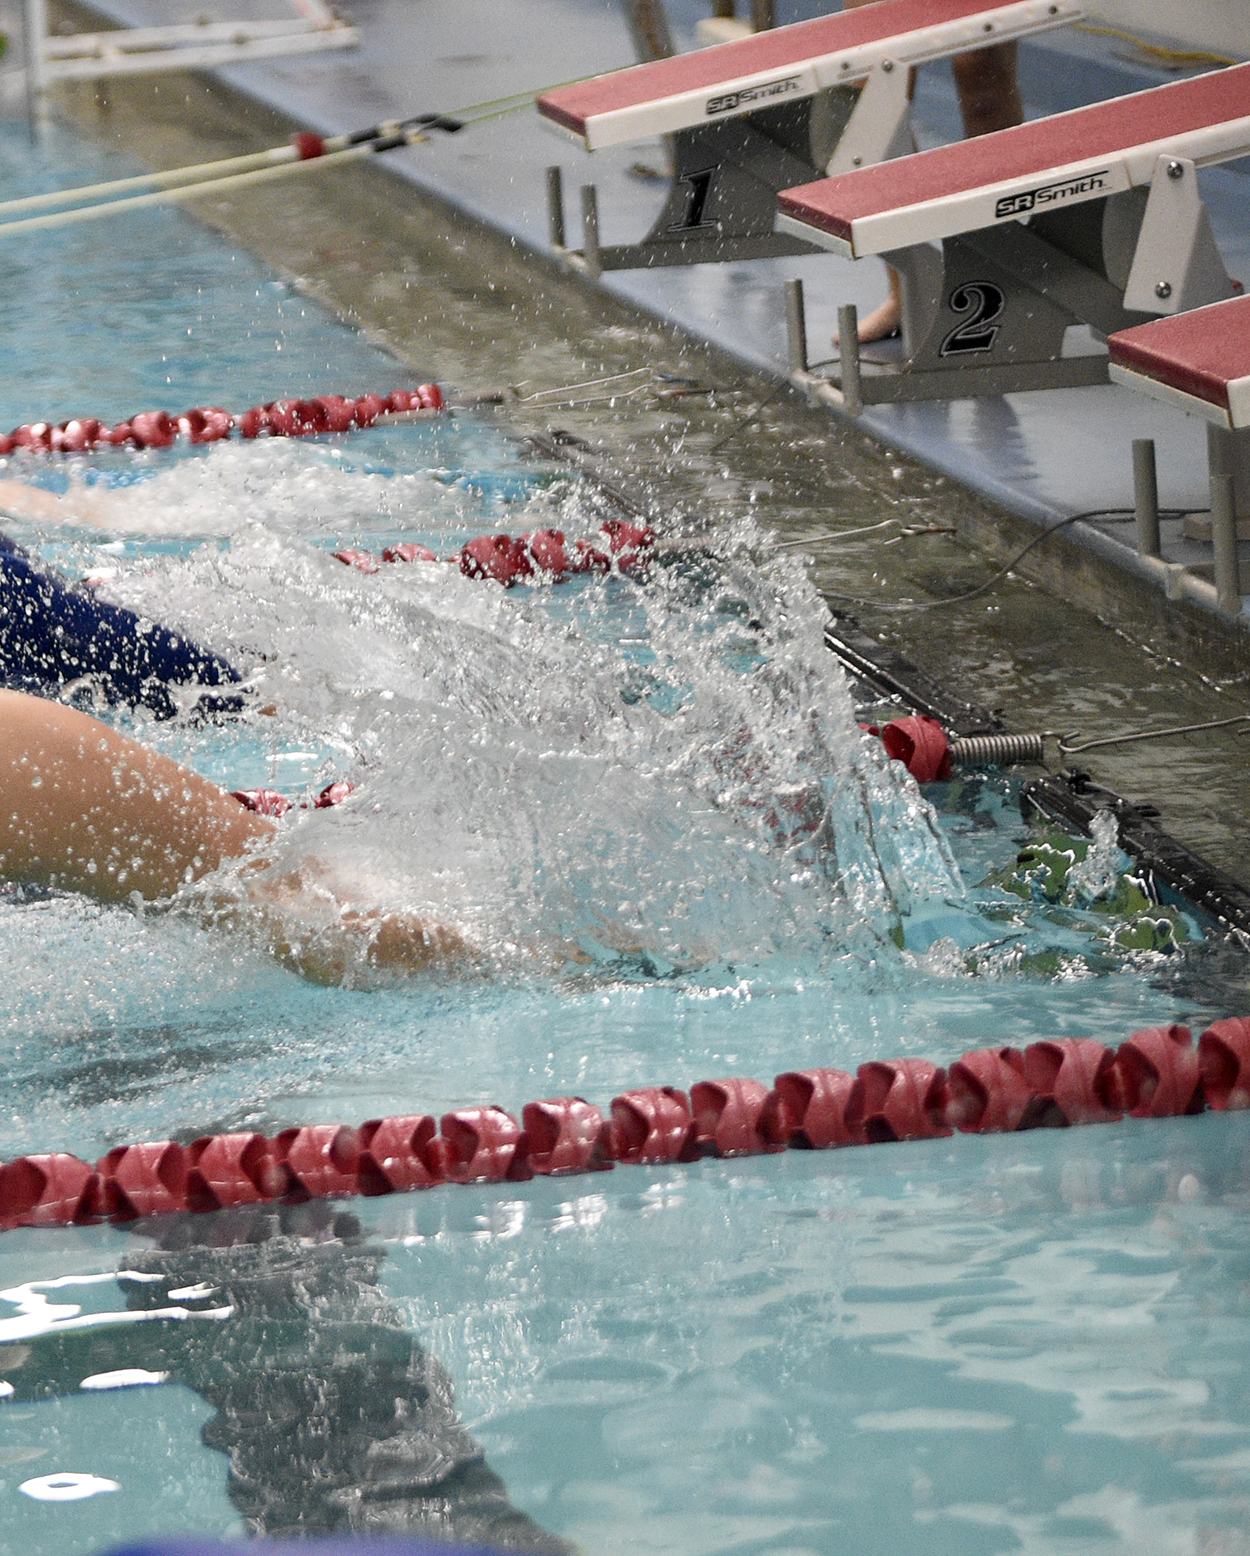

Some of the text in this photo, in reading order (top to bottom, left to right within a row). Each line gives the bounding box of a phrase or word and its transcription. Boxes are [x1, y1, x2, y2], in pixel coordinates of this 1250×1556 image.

[667, 165, 719, 234] 1
[1034, 178, 1103, 204] Smith
[938, 280, 1005, 357] 2
